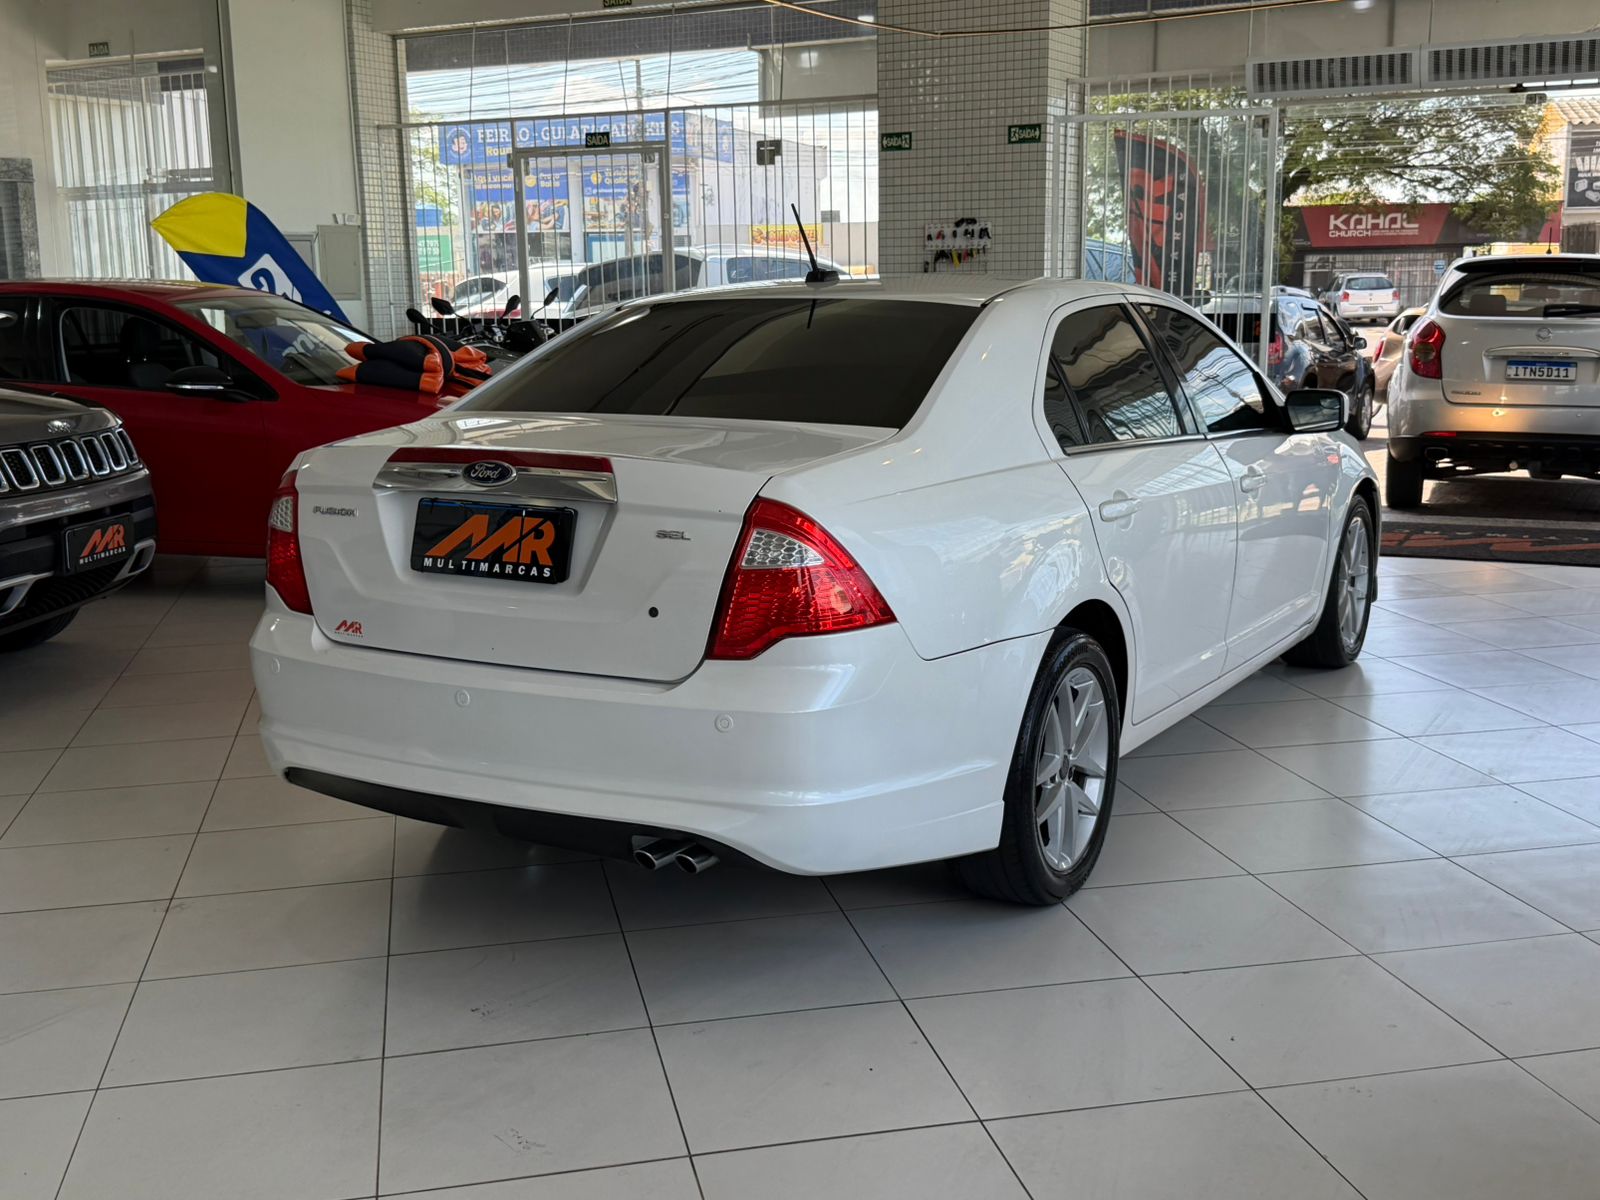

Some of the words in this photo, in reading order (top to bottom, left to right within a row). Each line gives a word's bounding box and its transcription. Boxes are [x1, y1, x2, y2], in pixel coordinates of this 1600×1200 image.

[1329, 212, 1419, 230] KAHAL
[1329, 230, 1371, 238] CHURCH
[1514, 366, 1569, 378] ITN5D11
[470, 462, 501, 479] Ford
[313, 506, 356, 517] FUSION
[656, 529, 691, 541] SEL
[423, 557, 551, 578] MULTIMARCAS
